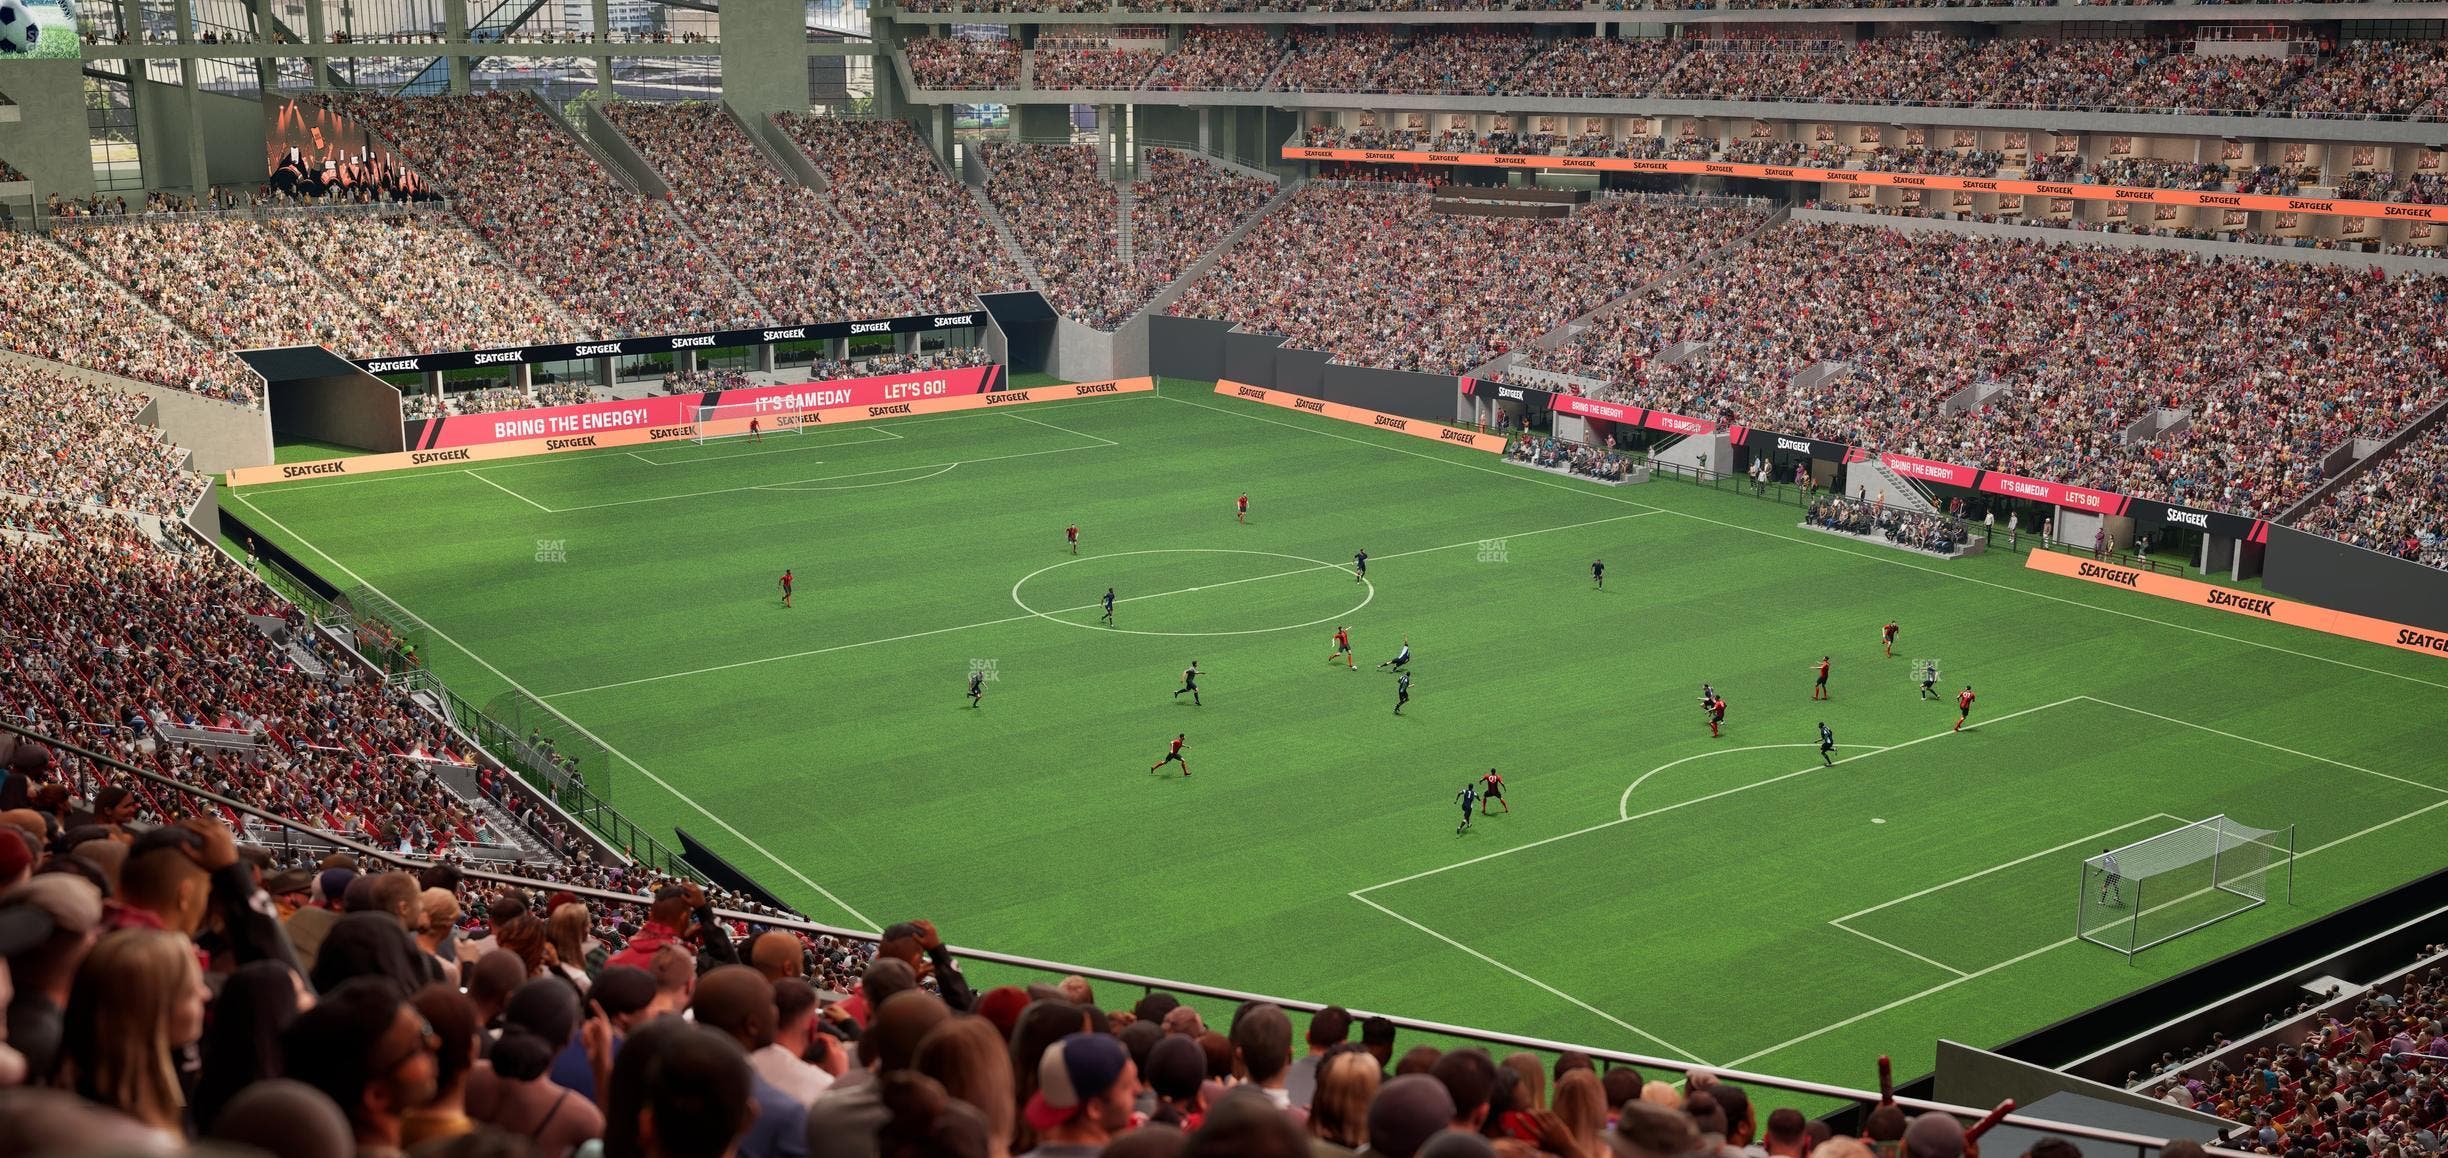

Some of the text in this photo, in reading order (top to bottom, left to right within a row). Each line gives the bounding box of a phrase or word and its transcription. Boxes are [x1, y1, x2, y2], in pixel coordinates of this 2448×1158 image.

[1893, 176, 1925, 185] SEATGEEK
[1963, 180, 1997, 190] SEATGEEK
[2037, 185, 2073, 194] SEATGEEK
[2116, 190, 2154, 200] SEATGEEK
[2200, 195, 2240, 206] SEATGEEK
[2289, 201, 2332, 211] SEATGEEK
[2385, 207, 2431, 217] SEATGEEK
[851, 321, 891, 334] SEATGEEK
[934, 315, 972, 327] SEATGEEK
[672, 335, 715, 348] SEATGEEK
[763, 328, 805, 341] SEATGEEK
[576, 343, 622, 356] SEATGEEK
[475, 350, 523, 364] SEATGEEK
[368, 359, 419, 373] SEATGEEK
[885, 380, 946, 399] LET'S GO!
[1076, 383, 1118, 395] SEATGEEK
[1238, 386, 1266, 400] SEATGEEK
[1498, 387, 1524, 400] SEATGEEK
[756, 389, 852, 412] IT'S GAMEDAY
[986, 392, 1029, 404] SEATGEEK
[1294, 398, 1325, 412] SEATGEEK
[869, 403, 911, 417] SEATGEEK
[495, 409, 648, 438] BRING THE ENERGY!
[776, 413, 822, 426] SEATGEEK
[1375, 415, 1407, 430] SEATGEEK
[650, 425, 697, 440] SEATGEEK
[1441, 428, 1476, 445] SEATGEEK
[546, 436, 596, 450] SEATGEEK
[1777, 438, 1810, 454] SEATGEEK
[412, 448, 470, 464] SEATGEEK
[283, 461, 345, 478] SEATGEEK
[1912, 463, 1924, 474] THE
[1925, 465, 1953, 479] ENERGY!
[2001, 480, 2049, 497] IT'S GAMEDAY
[2065, 491, 2085, 504] LET'S
[2167, 508, 2208, 528] SEATGEEK
[2078, 562, 2140, 587] SEATGEEK
[2207, 590, 2275, 616] SEATGEEK
